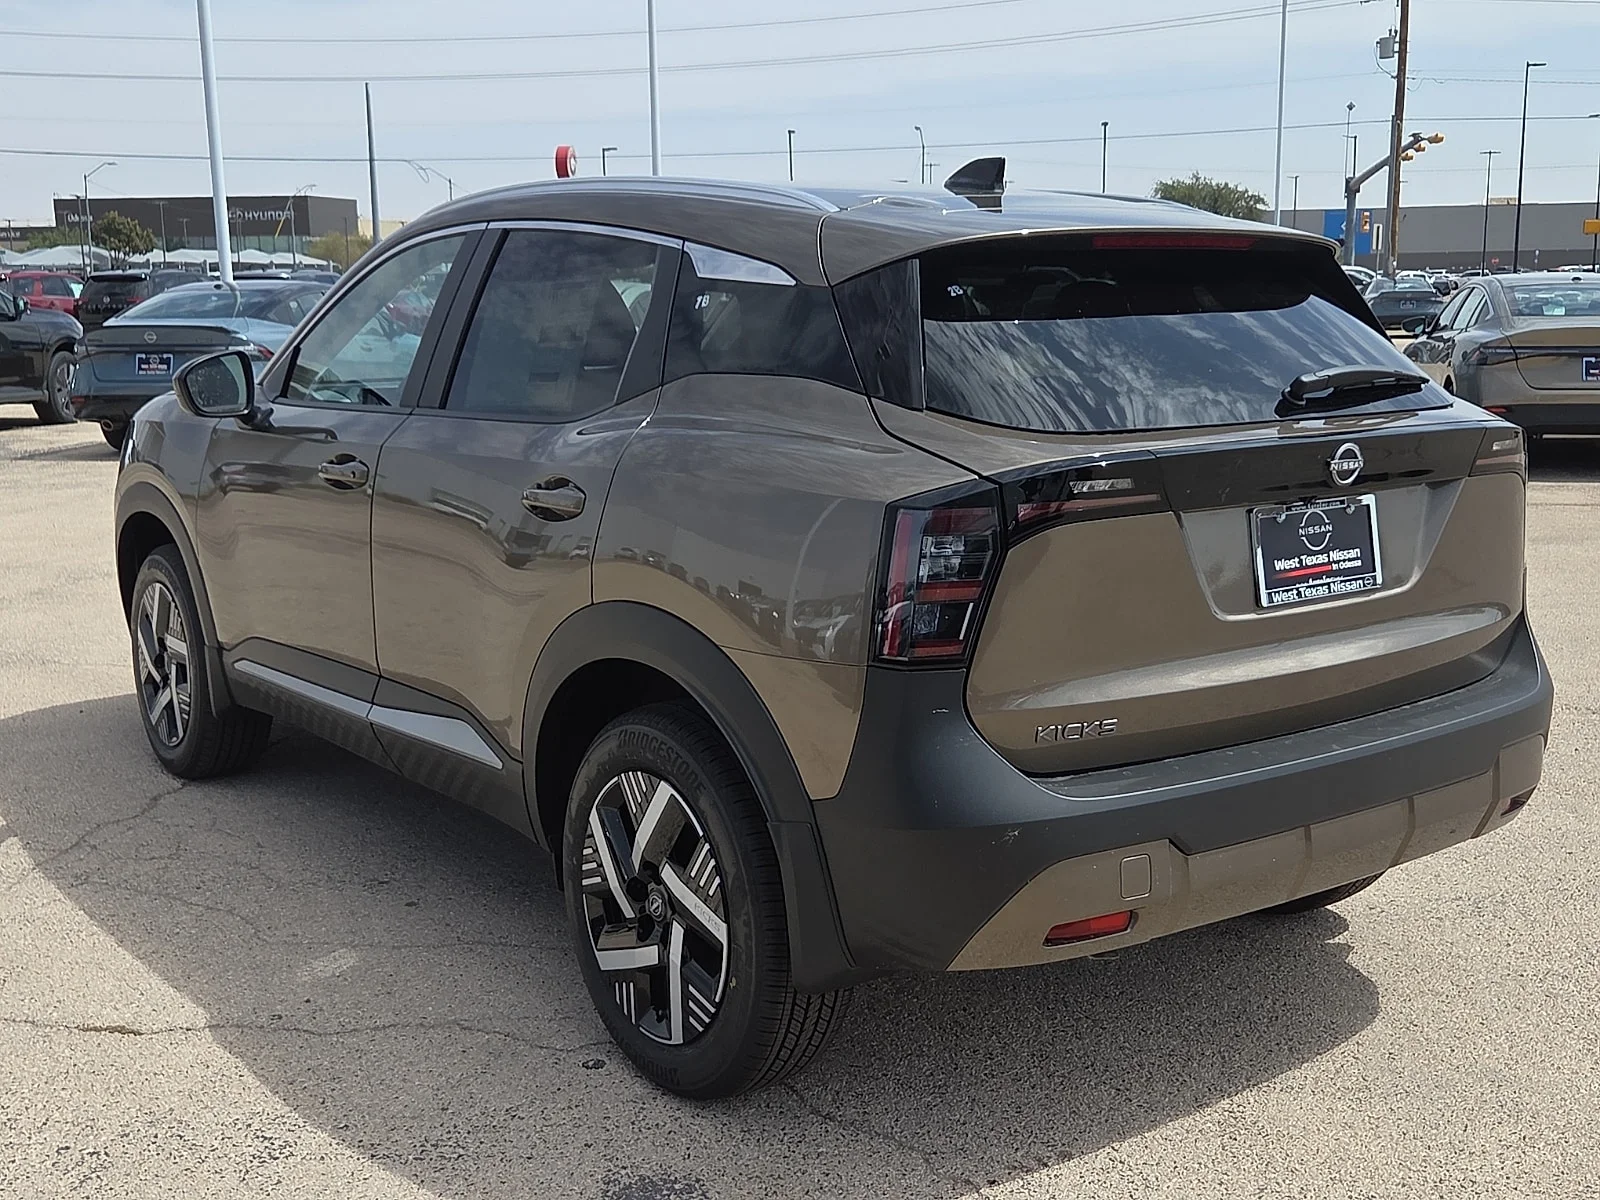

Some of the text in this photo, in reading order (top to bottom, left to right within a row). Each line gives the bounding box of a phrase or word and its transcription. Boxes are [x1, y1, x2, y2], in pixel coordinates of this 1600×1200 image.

[245, 210, 294, 221] HYUNDA
[1298, 524, 1333, 536] NISSAN
[1274, 547, 1361, 571] West Texas Nissan
[1339, 559, 1362, 570] Odessa
[1271, 591, 1300, 603] West
[1299, 584, 1329, 598] Texas
[1329, 578, 1364, 593] Nissan
[1034, 718, 1119, 744] KICKS
[618, 729, 707, 793] BRIDGESTONE
